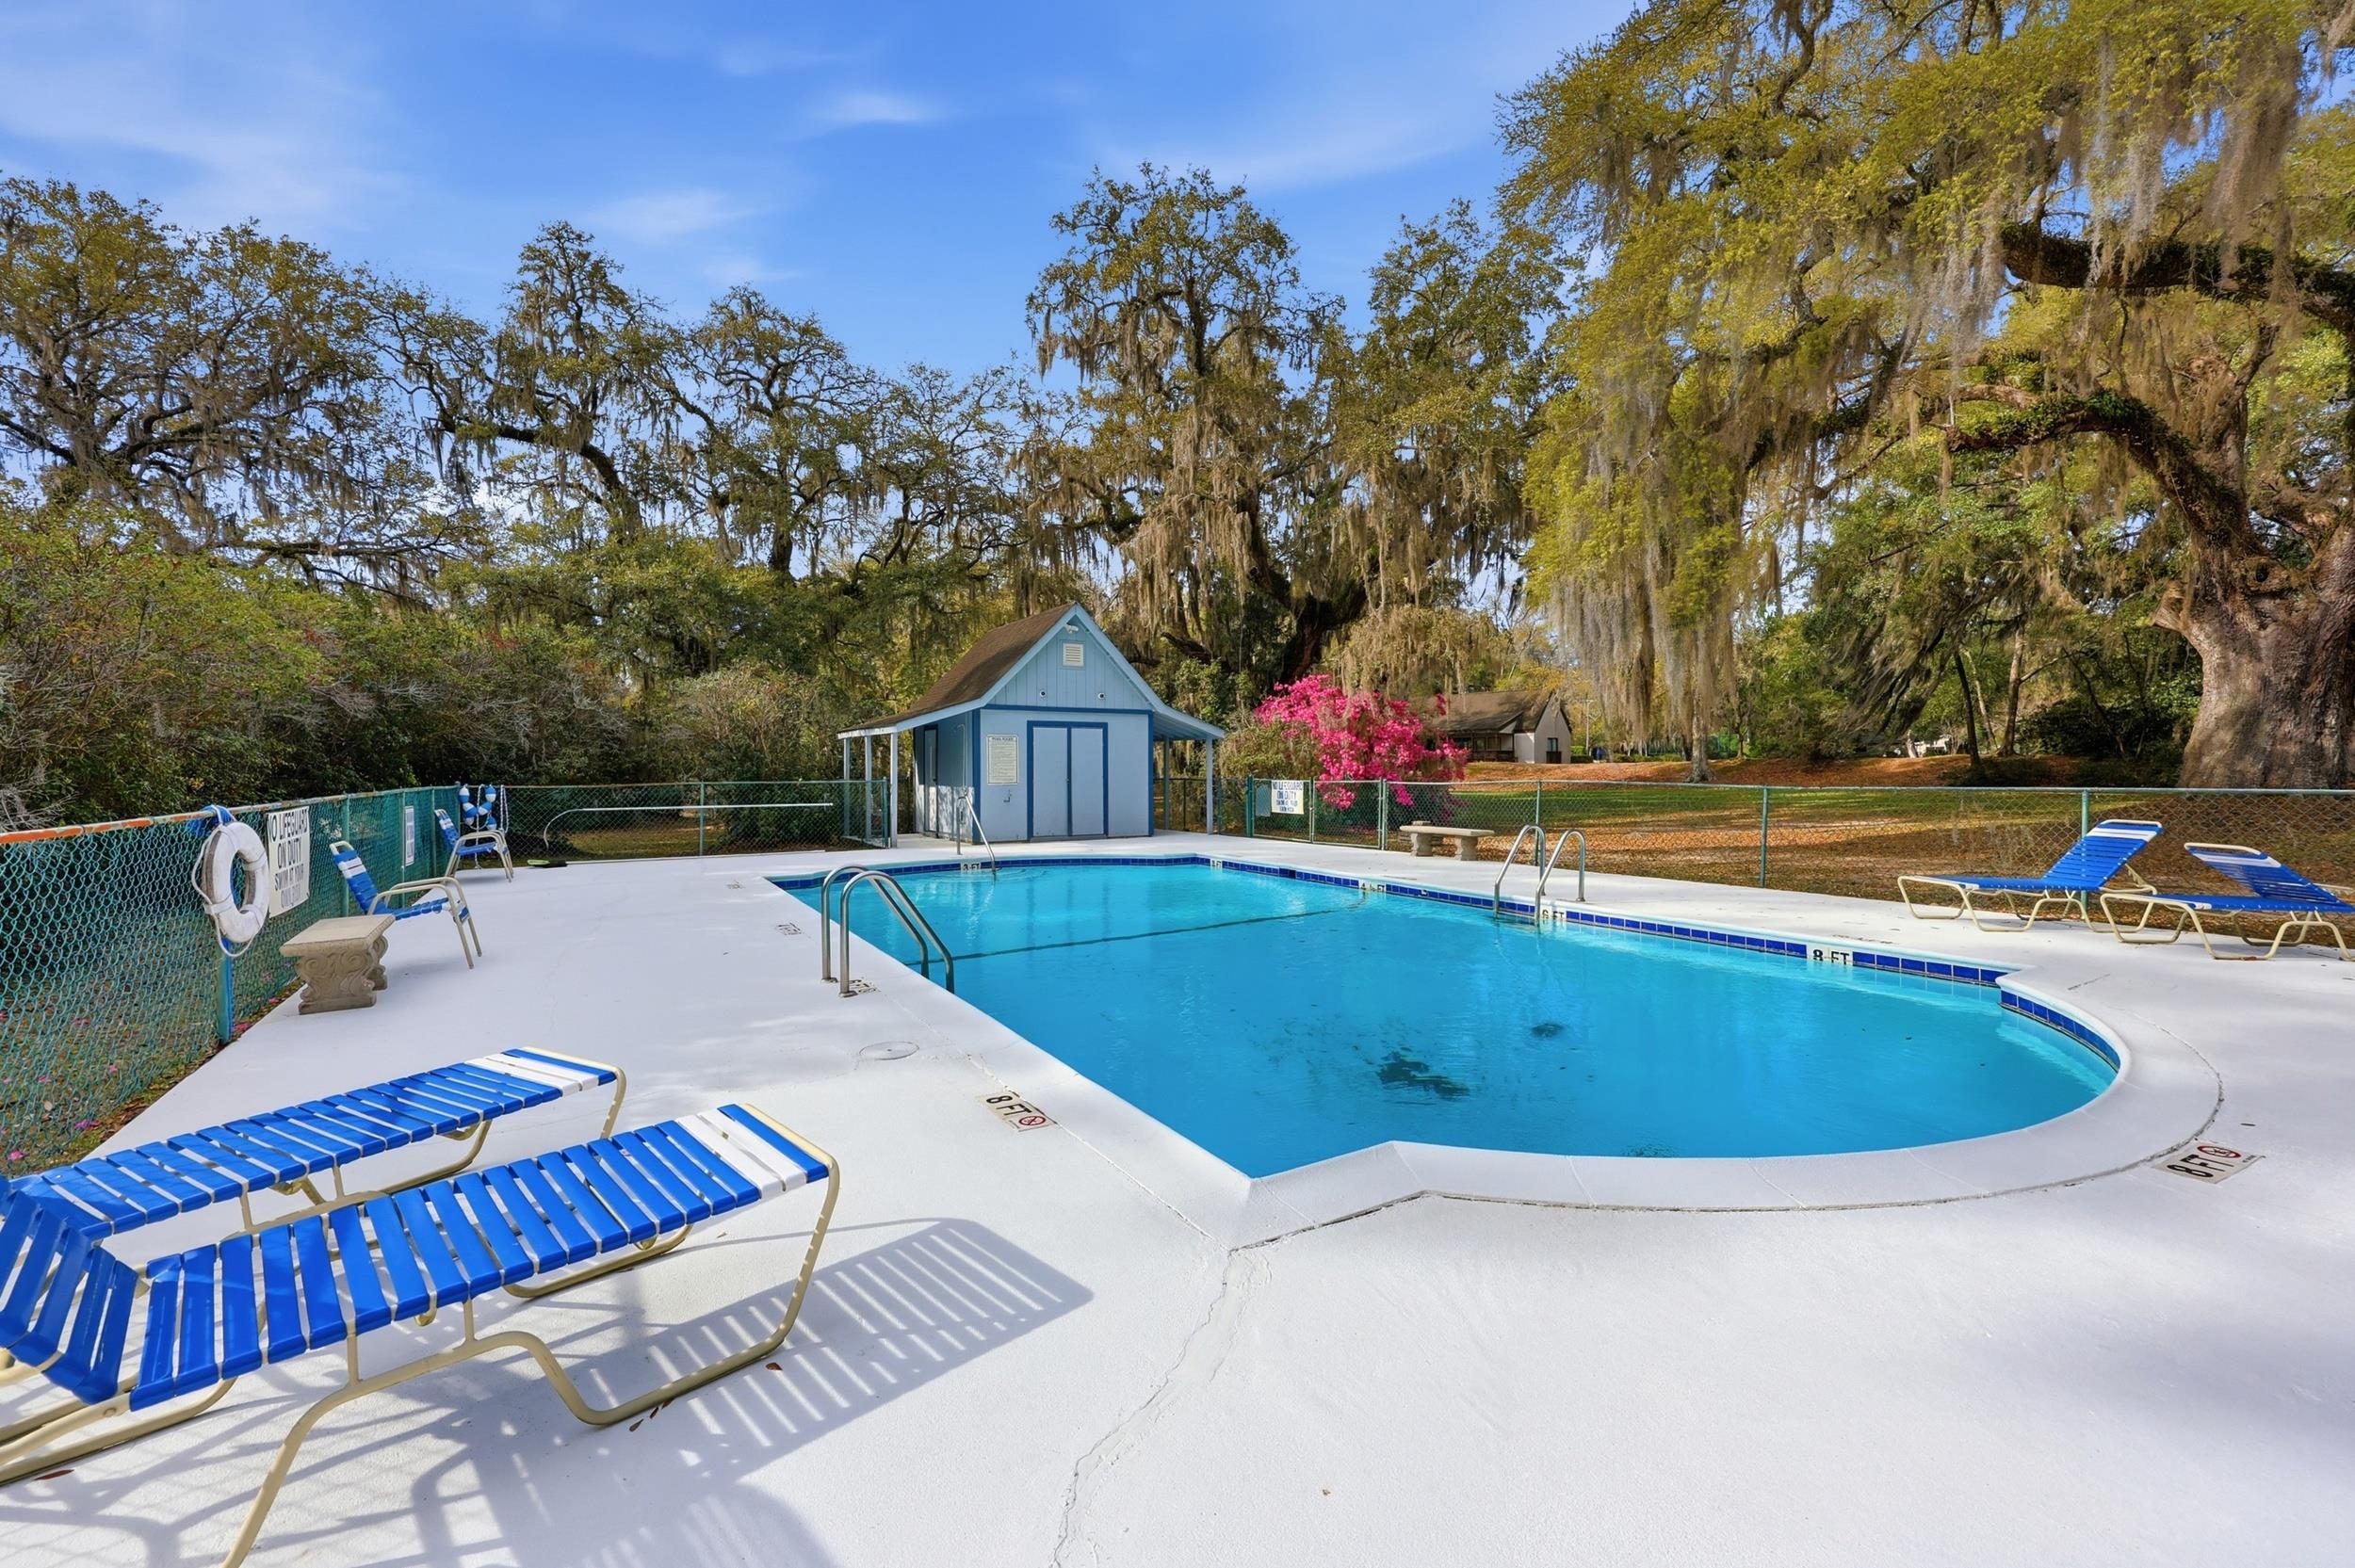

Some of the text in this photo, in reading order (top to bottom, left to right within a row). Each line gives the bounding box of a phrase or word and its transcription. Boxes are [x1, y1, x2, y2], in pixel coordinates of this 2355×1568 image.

[267, 813, 278, 842] NO
[278, 837, 301, 869] ON DUTY
[1552, 911, 1565, 920] FT
[1812, 949, 1850, 965] 8 FT
[986, 1095, 1032, 1116] 8 FT
[2167, 1164, 2214, 1178] 8
[2180, 1154, 2235, 1172] FT
